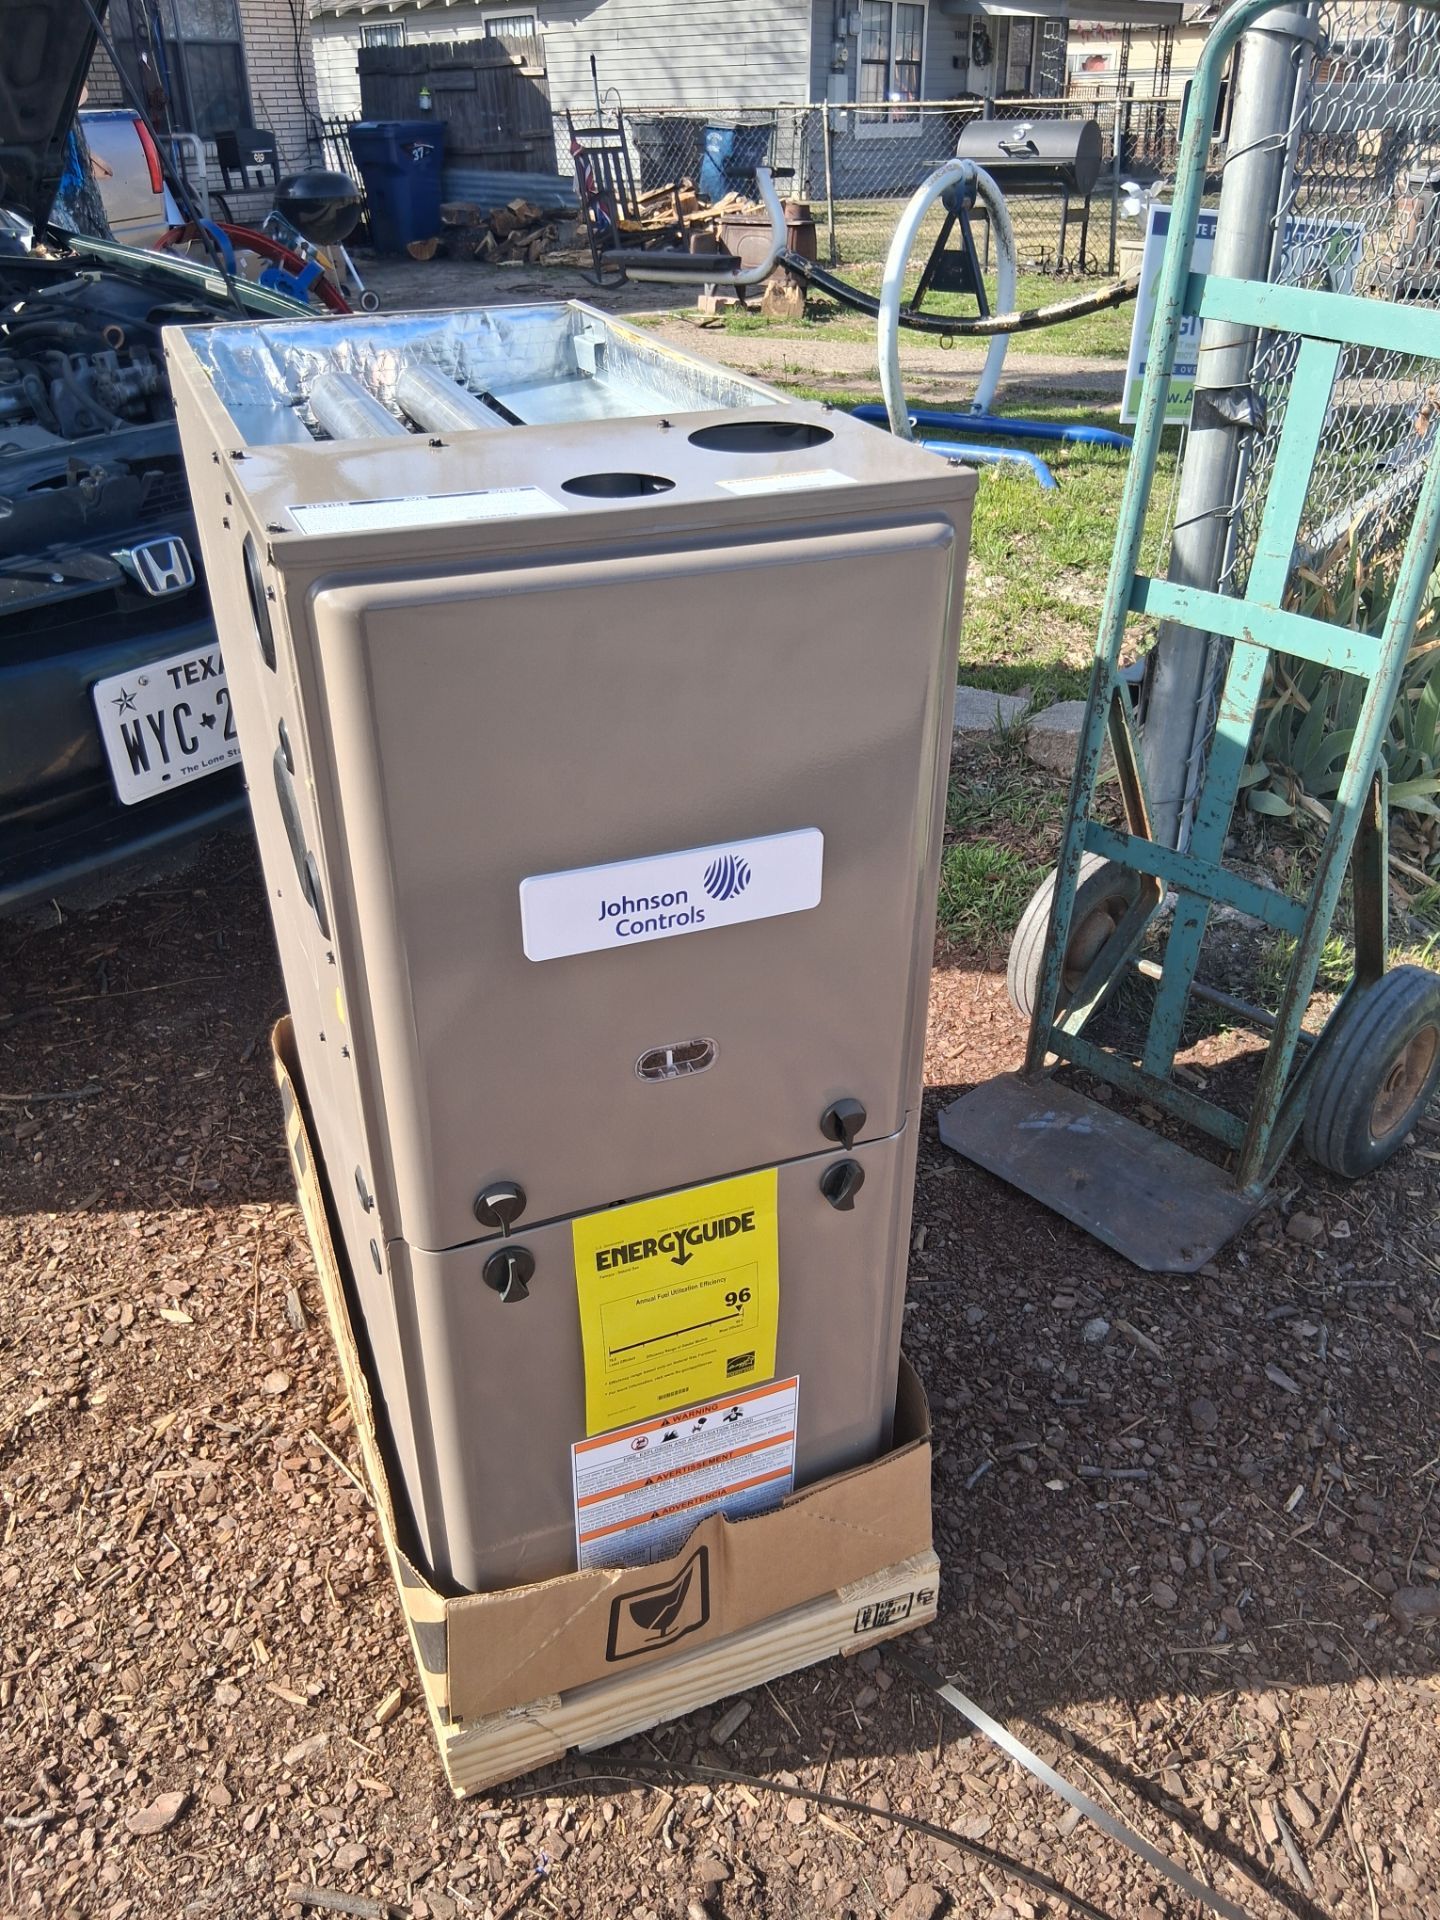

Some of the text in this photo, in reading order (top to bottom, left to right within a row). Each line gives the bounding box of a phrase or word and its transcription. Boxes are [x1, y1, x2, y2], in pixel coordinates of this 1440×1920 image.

[167, 653, 226, 690] TEX
[180, 764, 200, 776] The
[201, 754, 225, 768] Lone
[599, 889, 688, 921] Johnson
[615, 905, 706, 937] Controls
[596, 1210, 756, 1272] ENERGYGUIDE
[635, 1295, 656, 1306] Annual
[657, 1291, 670, 1300] Fuel
[699, 1276, 727, 1288] Efficiency
[725, 1287, 752, 1307] 96
[672, 1403, 719, 1423] WARNING
[656, 1451, 734, 1482] AVERTISSEMENT
[662, 1488, 728, 1515] ADVERTENCIA
